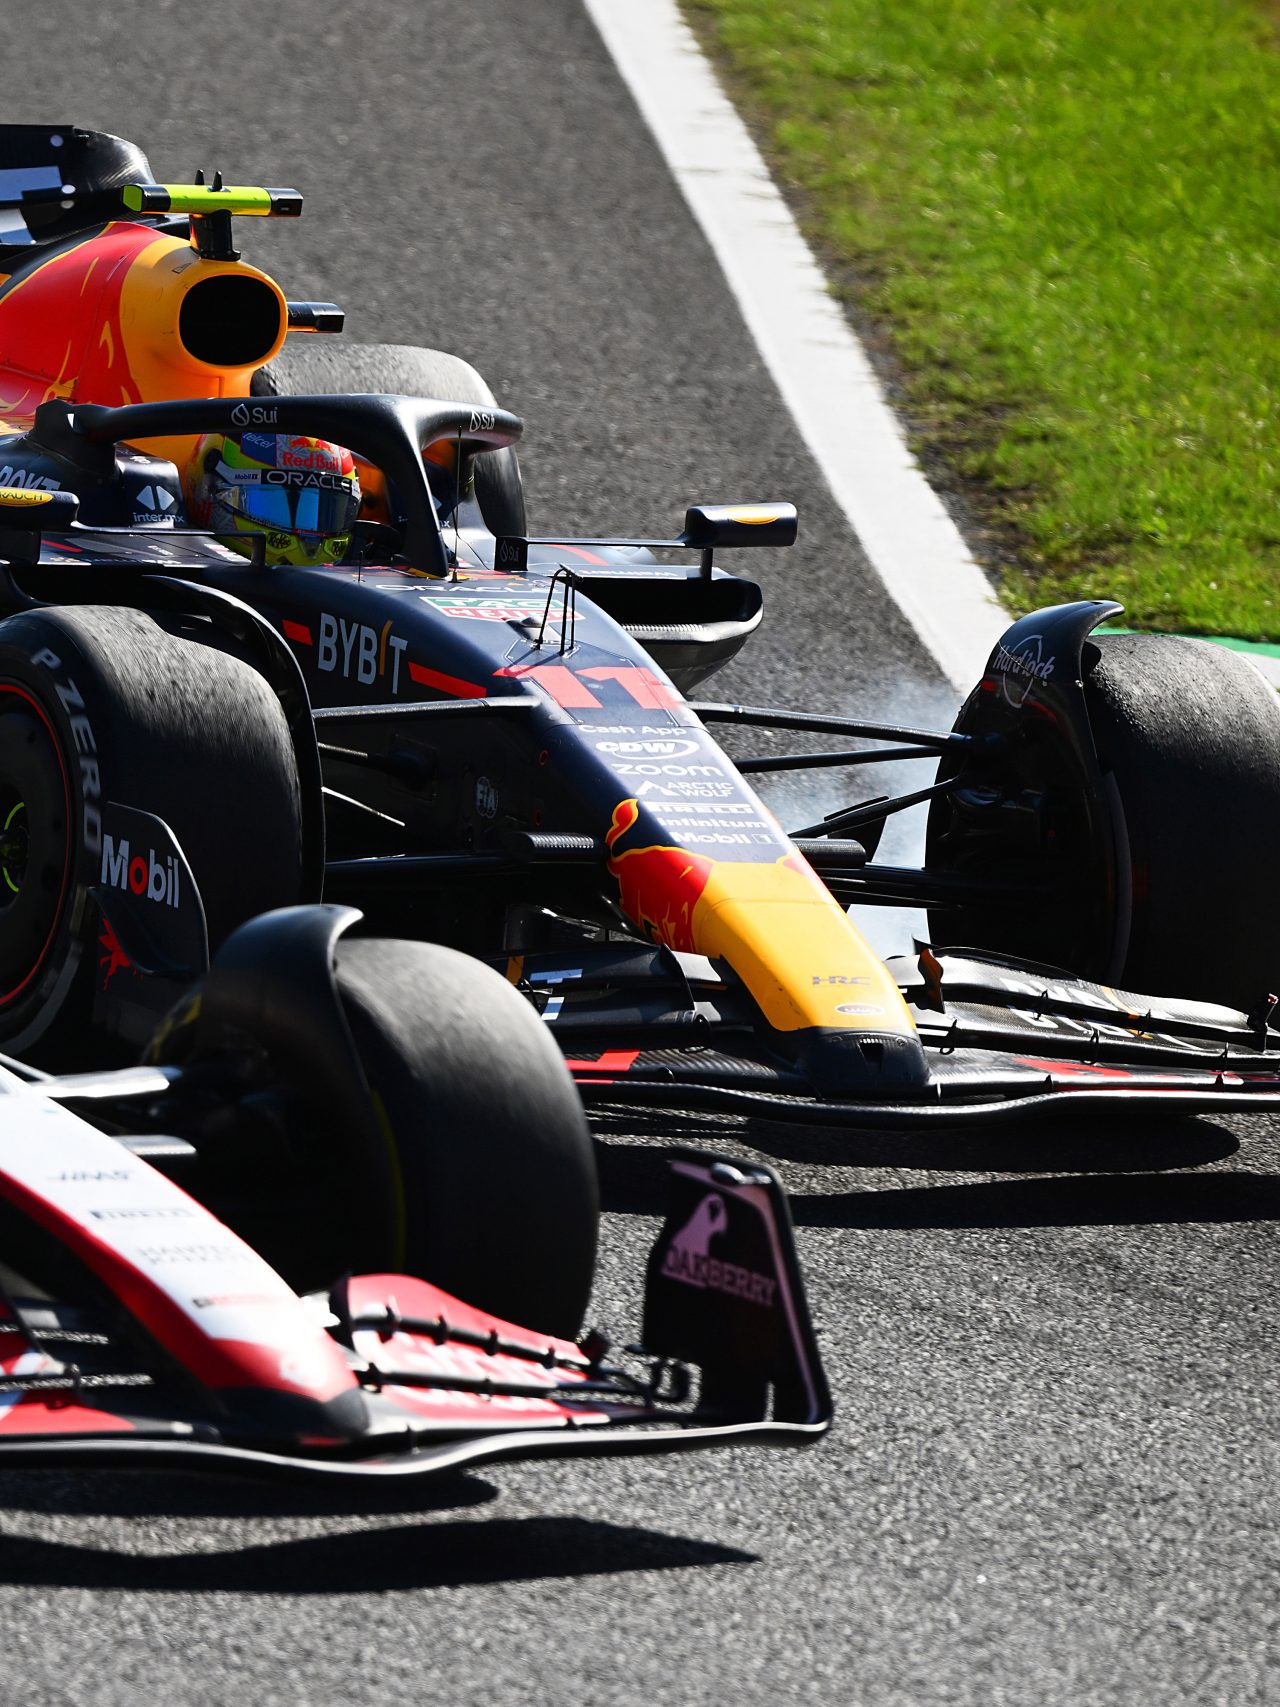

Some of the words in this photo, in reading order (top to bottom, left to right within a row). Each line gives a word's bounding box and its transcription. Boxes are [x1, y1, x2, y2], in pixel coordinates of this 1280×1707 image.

[252, 407, 278, 425] Sui
[282, 452, 313, 469] Red
[315, 455, 339, 472] Bull
[266, 470, 352, 492] ORACLE
[133, 512, 185, 523] inter.mx
[31, 647, 62, 671] P
[318, 612, 409, 695] BYBIT
[492, 665, 684, 710] 11
[578, 724, 635, 736] Cash
[641, 725, 688, 737] App
[595, 741, 677, 753] CDW
[610, 763, 725, 777] zoom
[666, 781, 735, 791] ARCTIC
[676, 790, 732, 798] WOLF
[658, 817, 770, 829] infinitum
[669, 831, 751, 844] Mobil
[100, 834, 180, 909] Mobil
[811, 975, 871, 986] HRC
